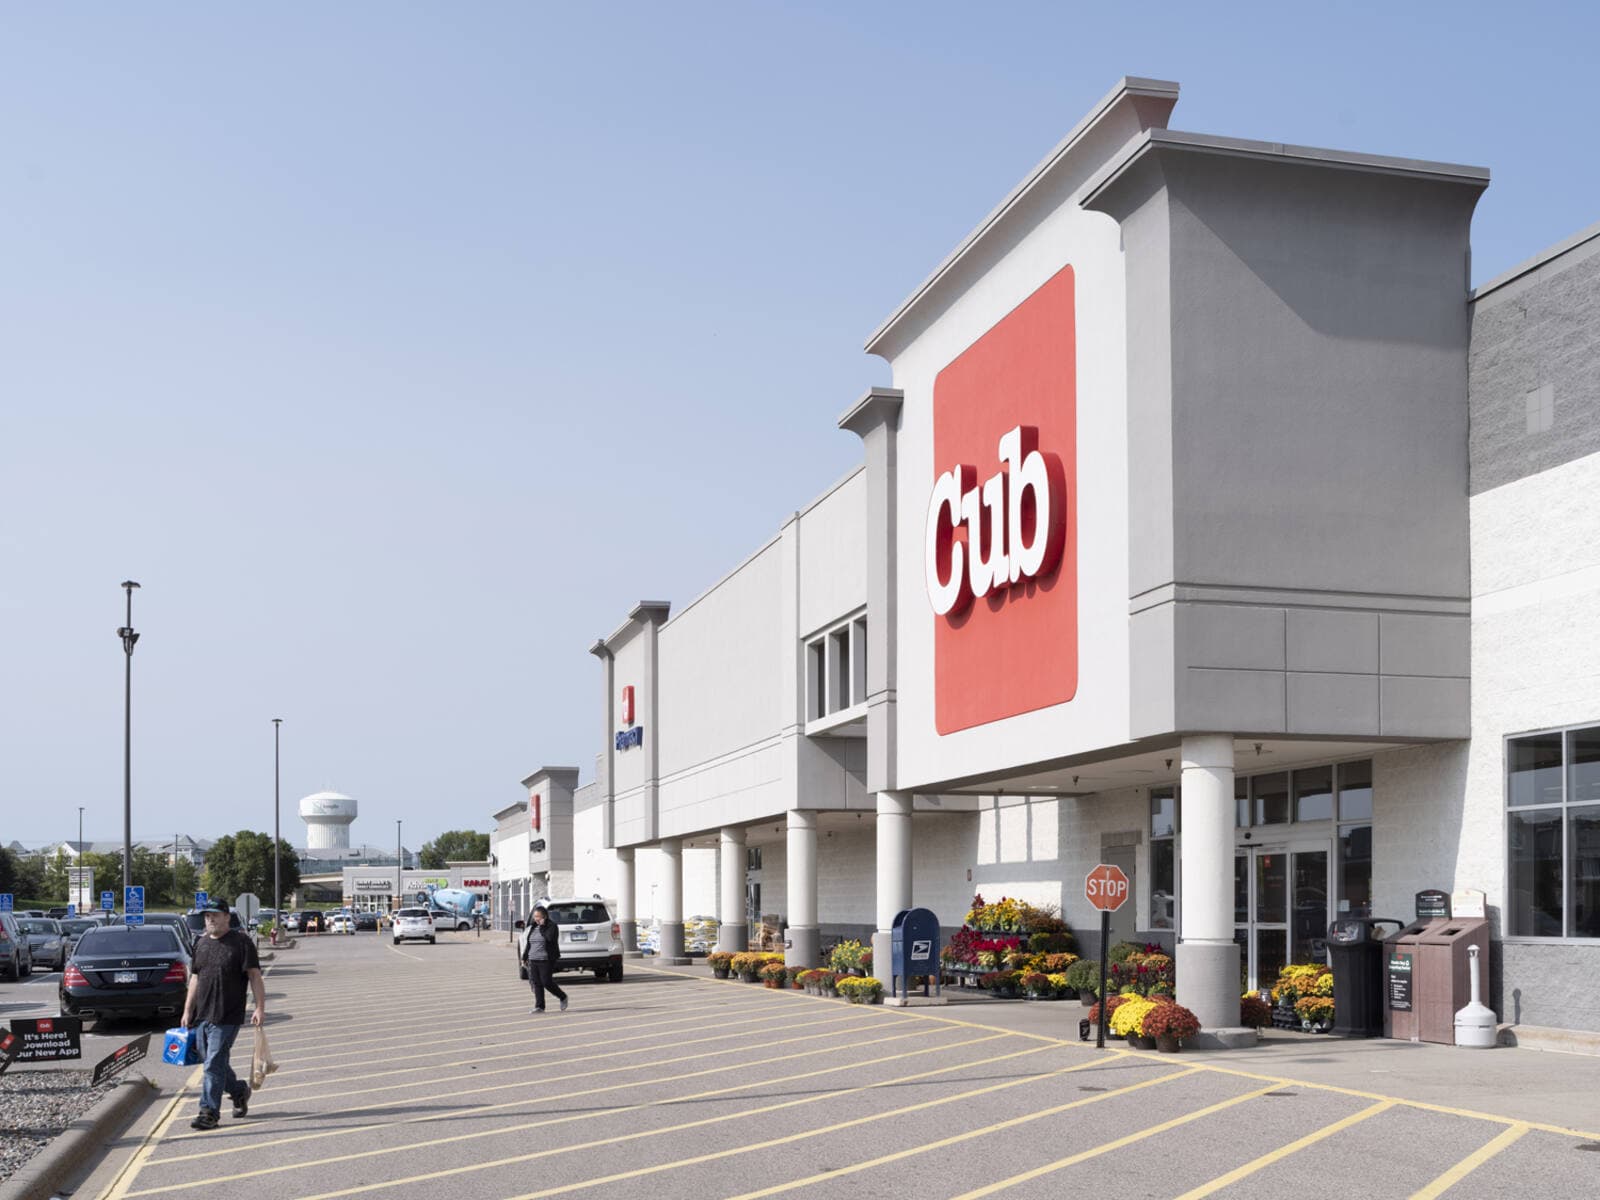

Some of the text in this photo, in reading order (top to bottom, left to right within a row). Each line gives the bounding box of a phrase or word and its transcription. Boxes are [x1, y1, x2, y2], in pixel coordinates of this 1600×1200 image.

[925, 425, 1050, 616] Cub
[1088, 879, 1126, 897] STOP
[24, 1032, 67, 1041] It's Here!
[35, 1049, 56, 1057] New
[59, 1048, 79, 1057] App
